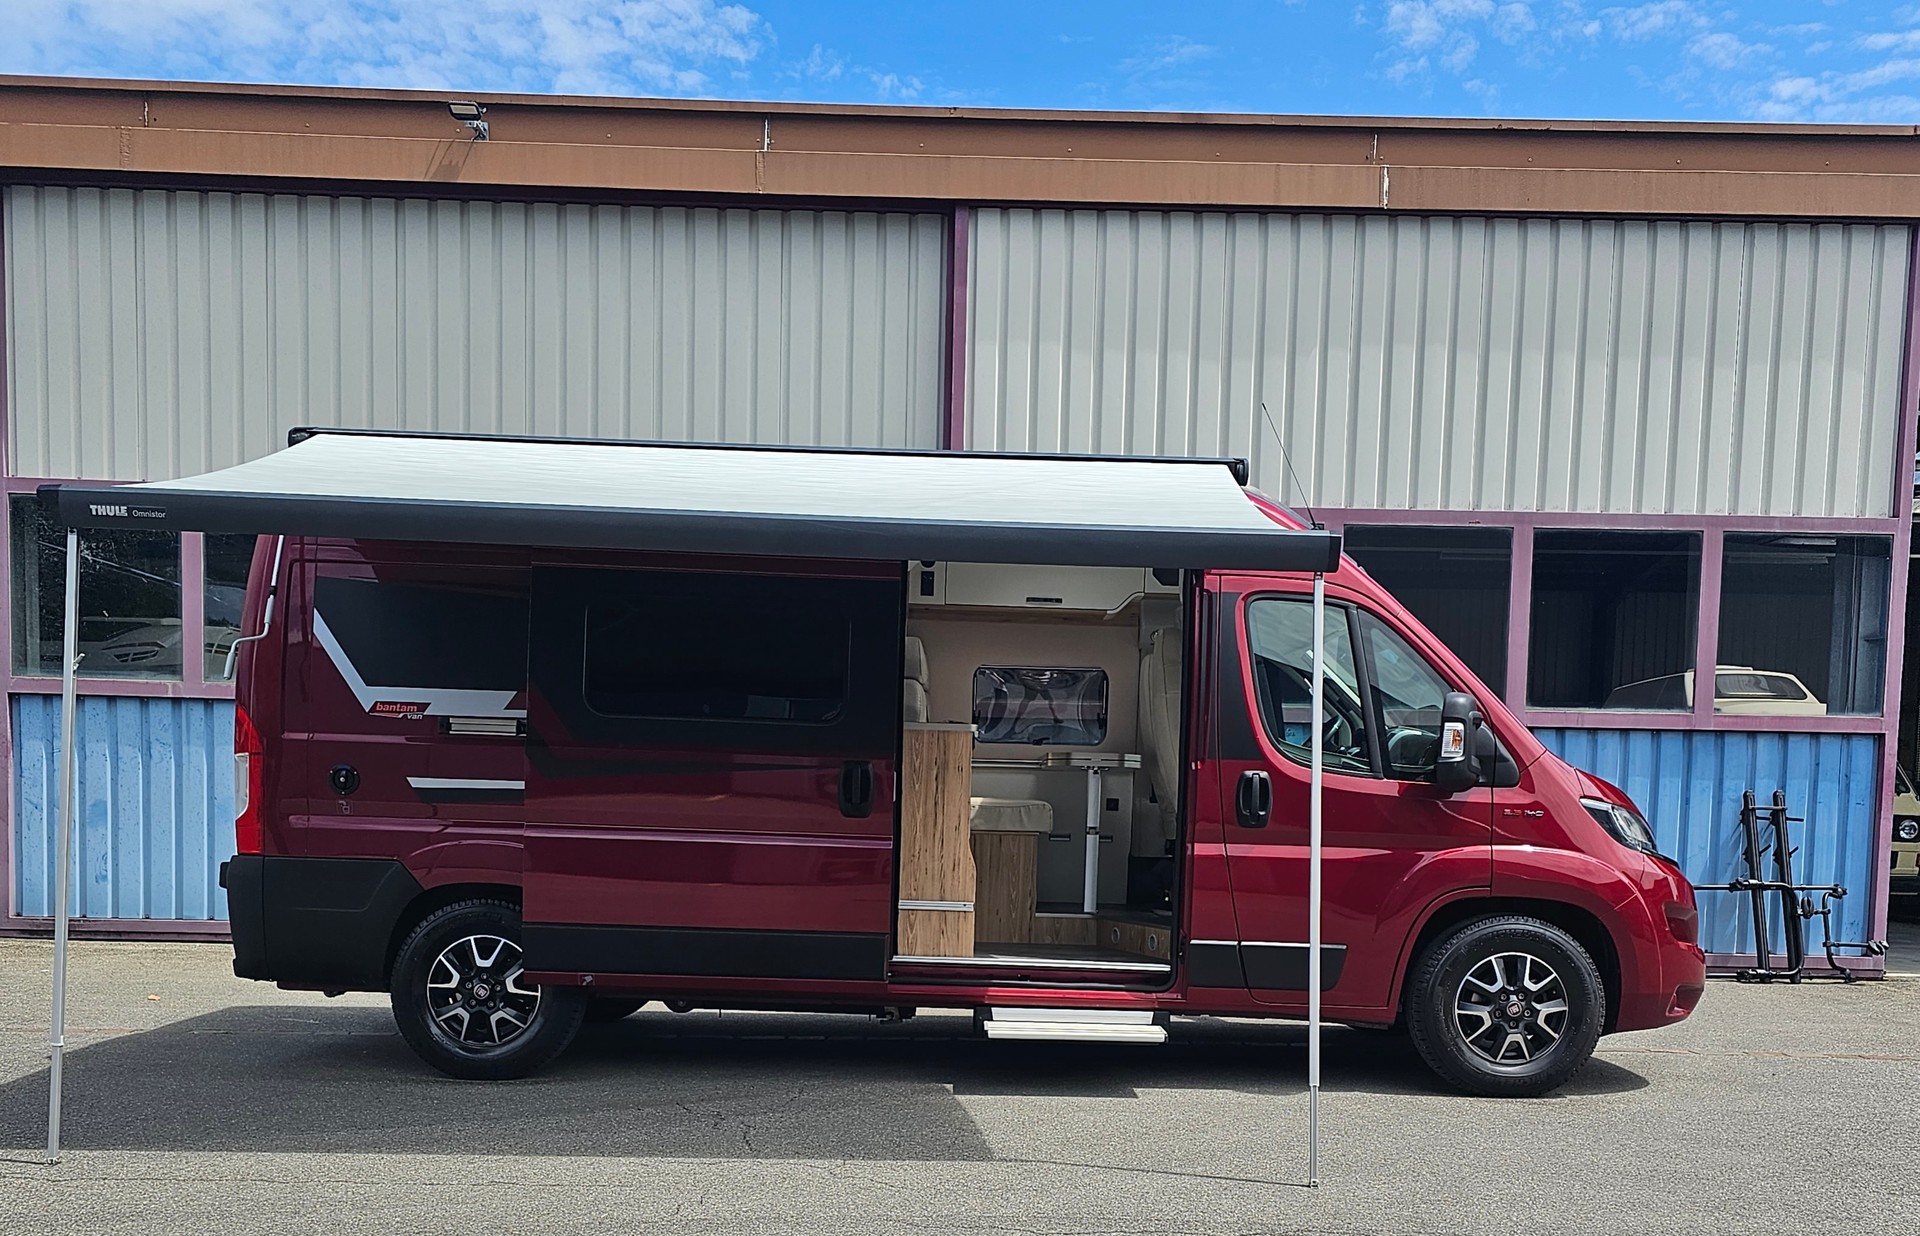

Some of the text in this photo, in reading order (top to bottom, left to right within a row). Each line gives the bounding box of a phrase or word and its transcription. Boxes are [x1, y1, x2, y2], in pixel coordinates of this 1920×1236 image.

[89, 504, 167, 519] THULE Omnistor
[376, 702, 418, 712] bantam
